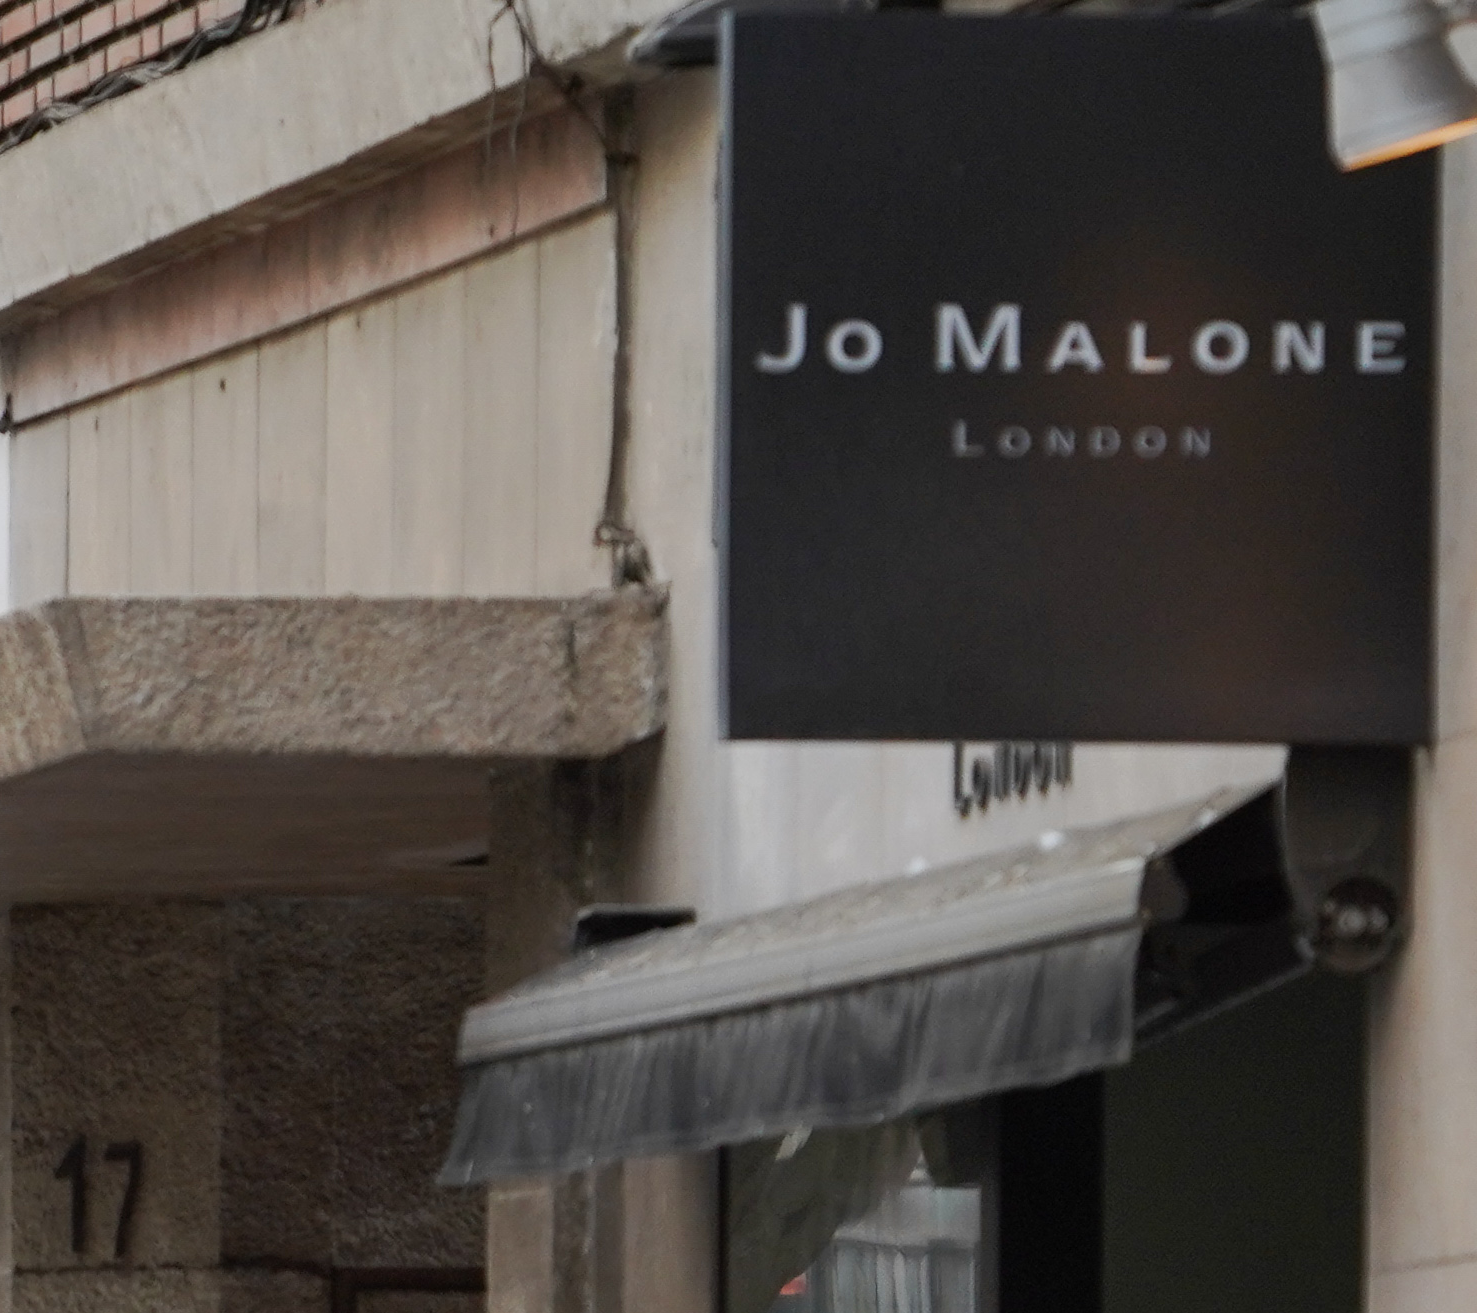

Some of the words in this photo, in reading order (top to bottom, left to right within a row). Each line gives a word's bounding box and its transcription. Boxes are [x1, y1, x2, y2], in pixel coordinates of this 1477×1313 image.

[756, 303, 884, 374] JO
[935, 303, 1407, 374] MALONE
[953, 420, 1214, 459] LONDON
[52, 1136, 145, 1257] 17
